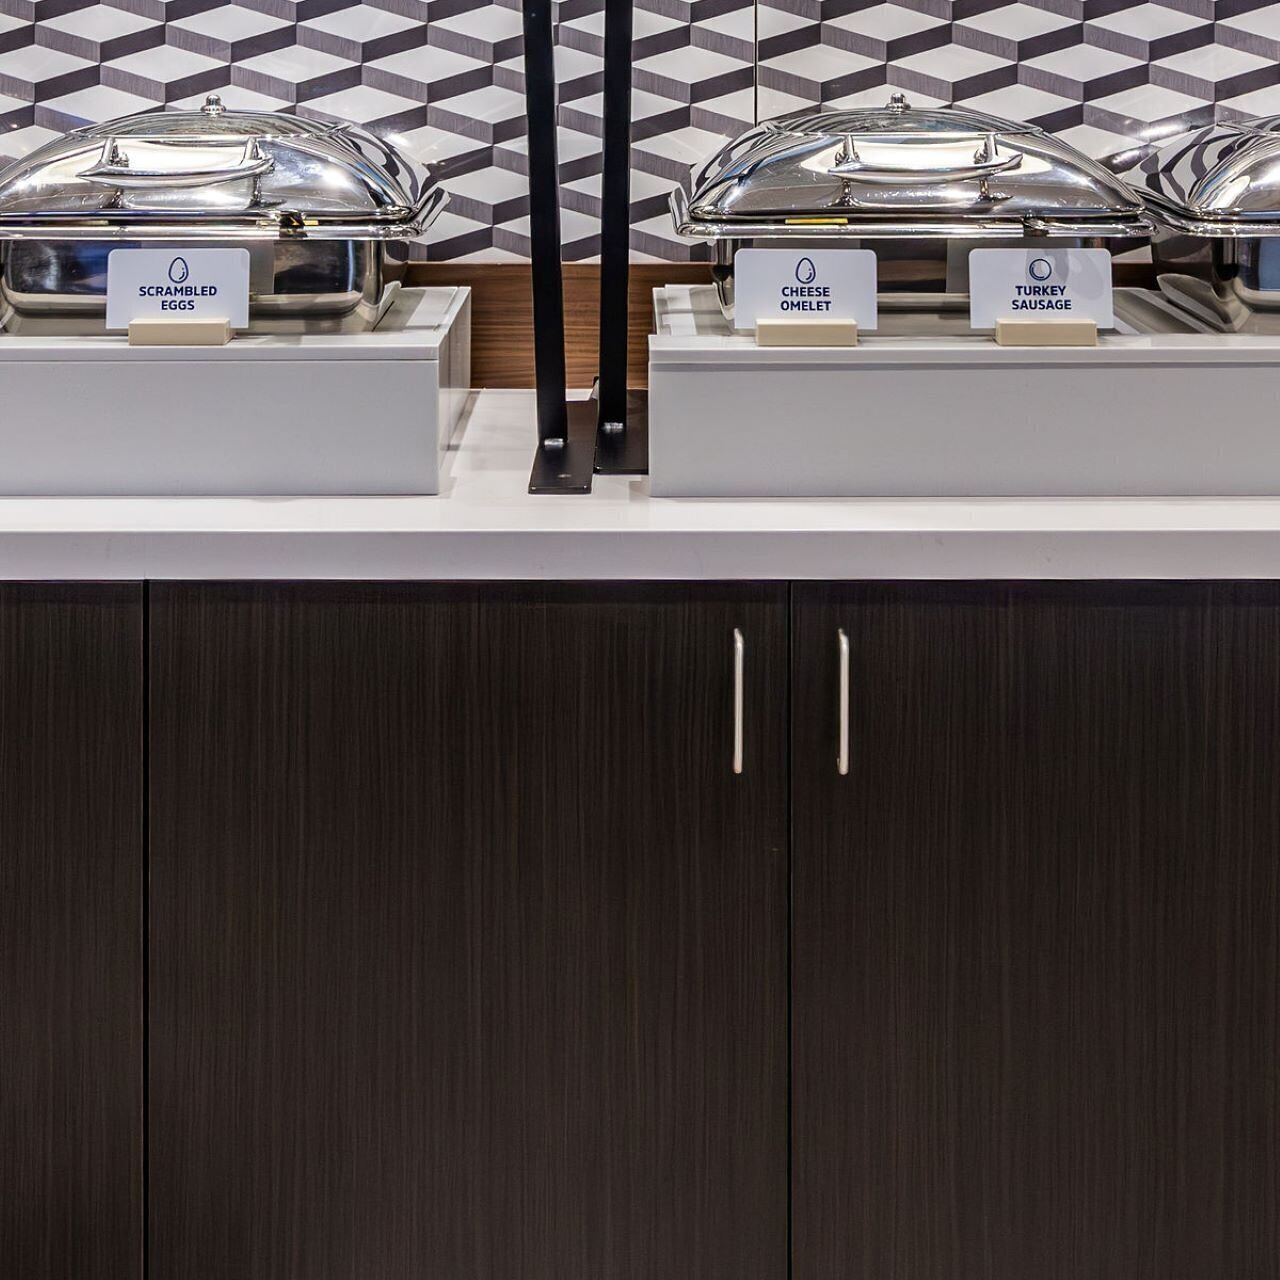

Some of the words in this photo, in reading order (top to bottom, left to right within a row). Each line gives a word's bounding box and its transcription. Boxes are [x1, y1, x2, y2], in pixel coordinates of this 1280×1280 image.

[138, 285, 218, 297] SCRAMBLED
[781, 286, 831, 298] CHEESE
[1015, 285, 1067, 296] TURKEY
[161, 299, 195, 311] EGGS
[780, 300, 832, 312] OMELET
[1011, 299, 1072, 311] SAUSAGE
